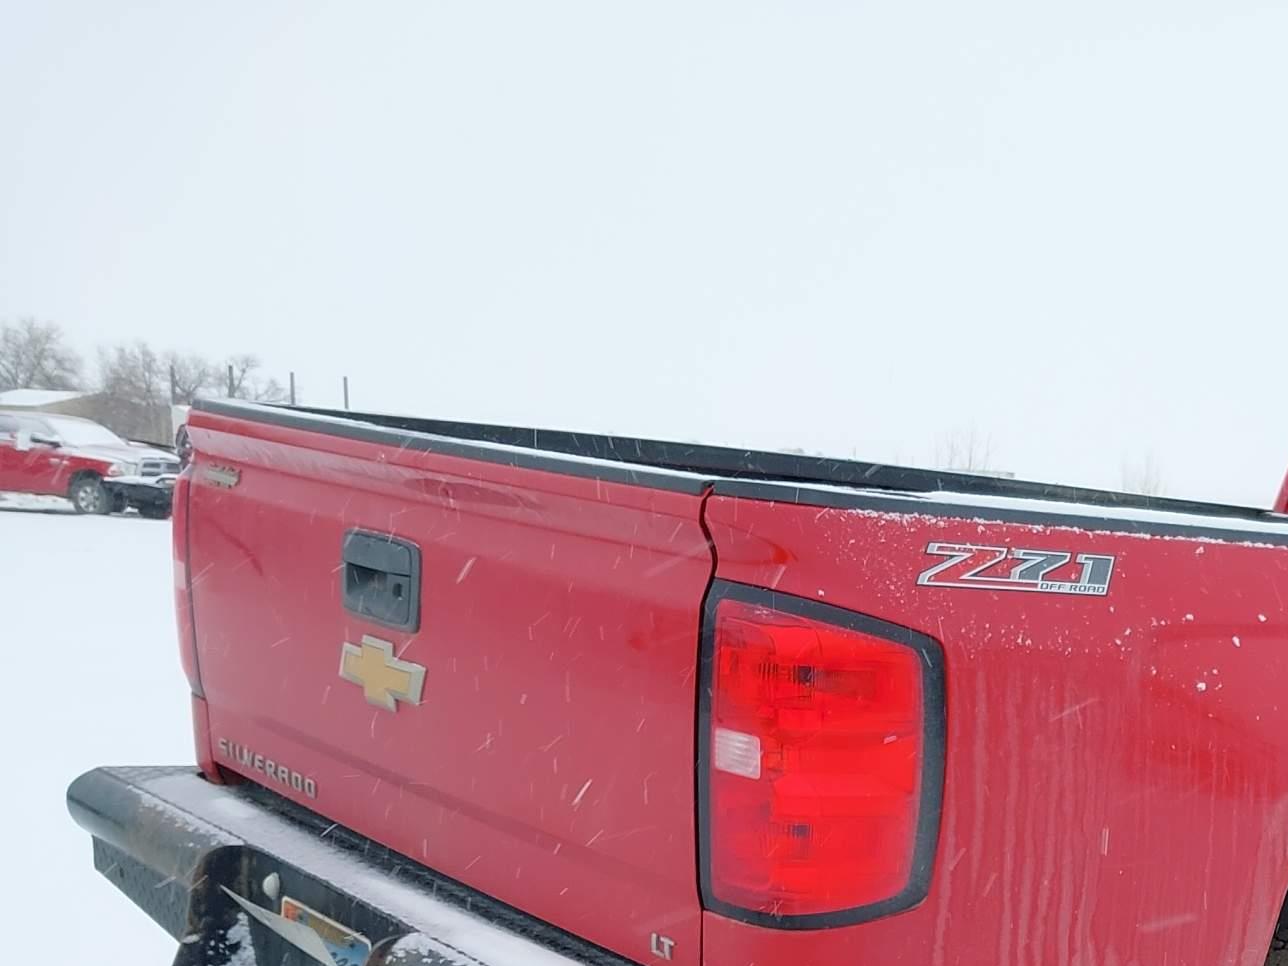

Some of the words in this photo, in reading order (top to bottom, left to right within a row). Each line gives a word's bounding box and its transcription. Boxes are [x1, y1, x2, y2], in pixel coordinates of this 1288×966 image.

[916, 541, 1118, 597] Z71
[1040, 582, 1066, 591] OFF
[1069, 584, 1106, 594] ROAD
[218, 738, 319, 800] SILVERADO
[651, 932, 675, 961] LT
